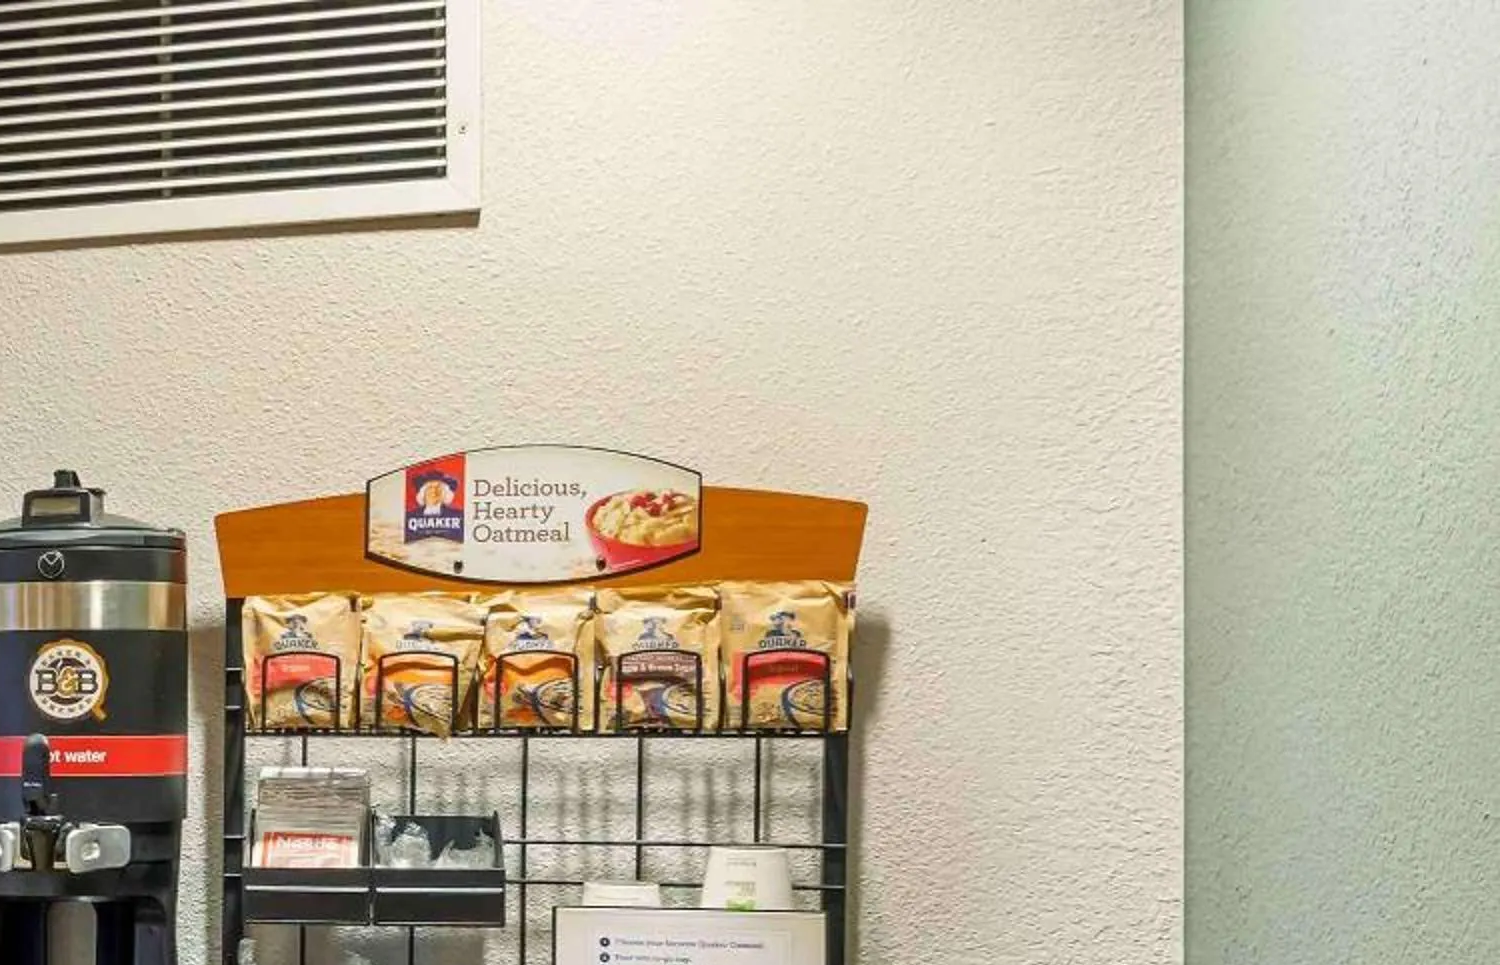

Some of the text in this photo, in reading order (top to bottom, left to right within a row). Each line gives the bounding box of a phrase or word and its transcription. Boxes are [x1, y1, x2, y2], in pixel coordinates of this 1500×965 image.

[473, 476, 587, 499] Delicious,
[473, 501, 555, 524] Hearty
[408, 517, 461, 531] QUAKER
[473, 522, 570, 543] Oatmeal
[64, 750, 107, 763] water
